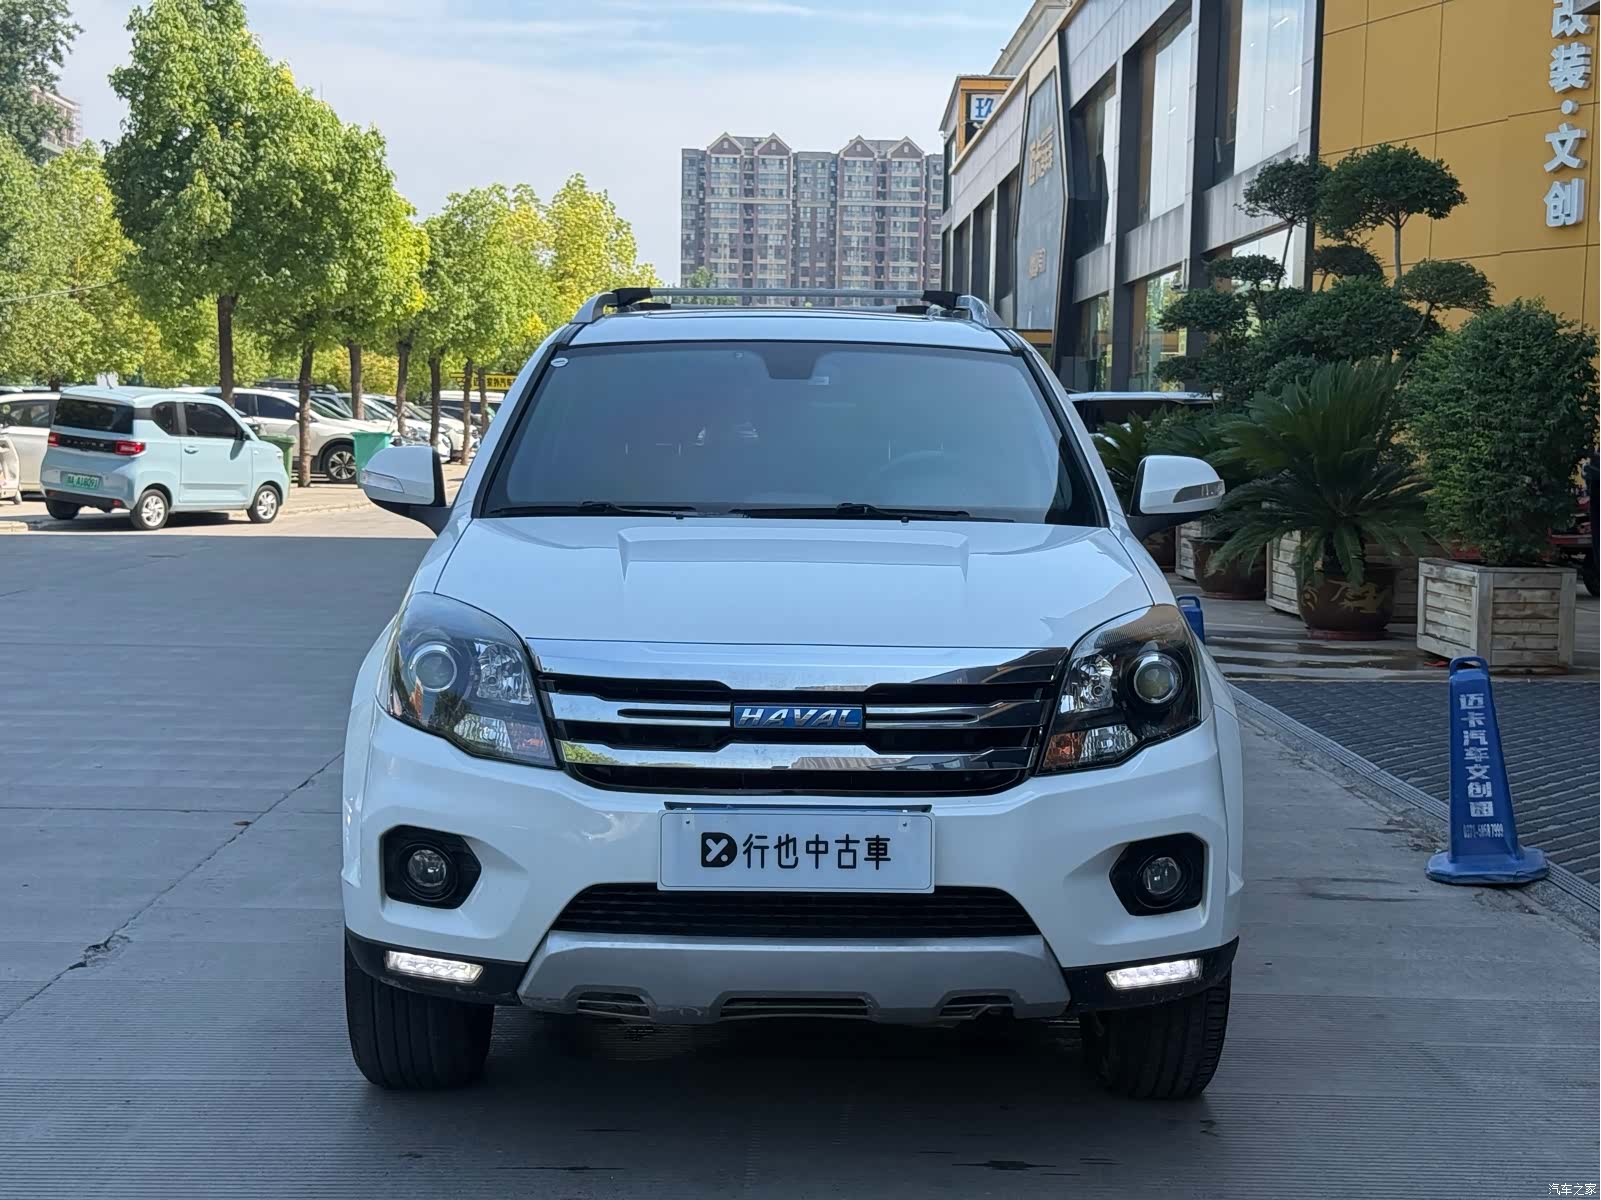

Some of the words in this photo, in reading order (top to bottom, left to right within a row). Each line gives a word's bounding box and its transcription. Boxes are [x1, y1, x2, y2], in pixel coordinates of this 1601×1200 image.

[738, 707, 861, 727] HAVAL
[1459, 693, 1494, 817] 迈卡汽车文创园
[742, 833, 891, 870] 行也中古車
